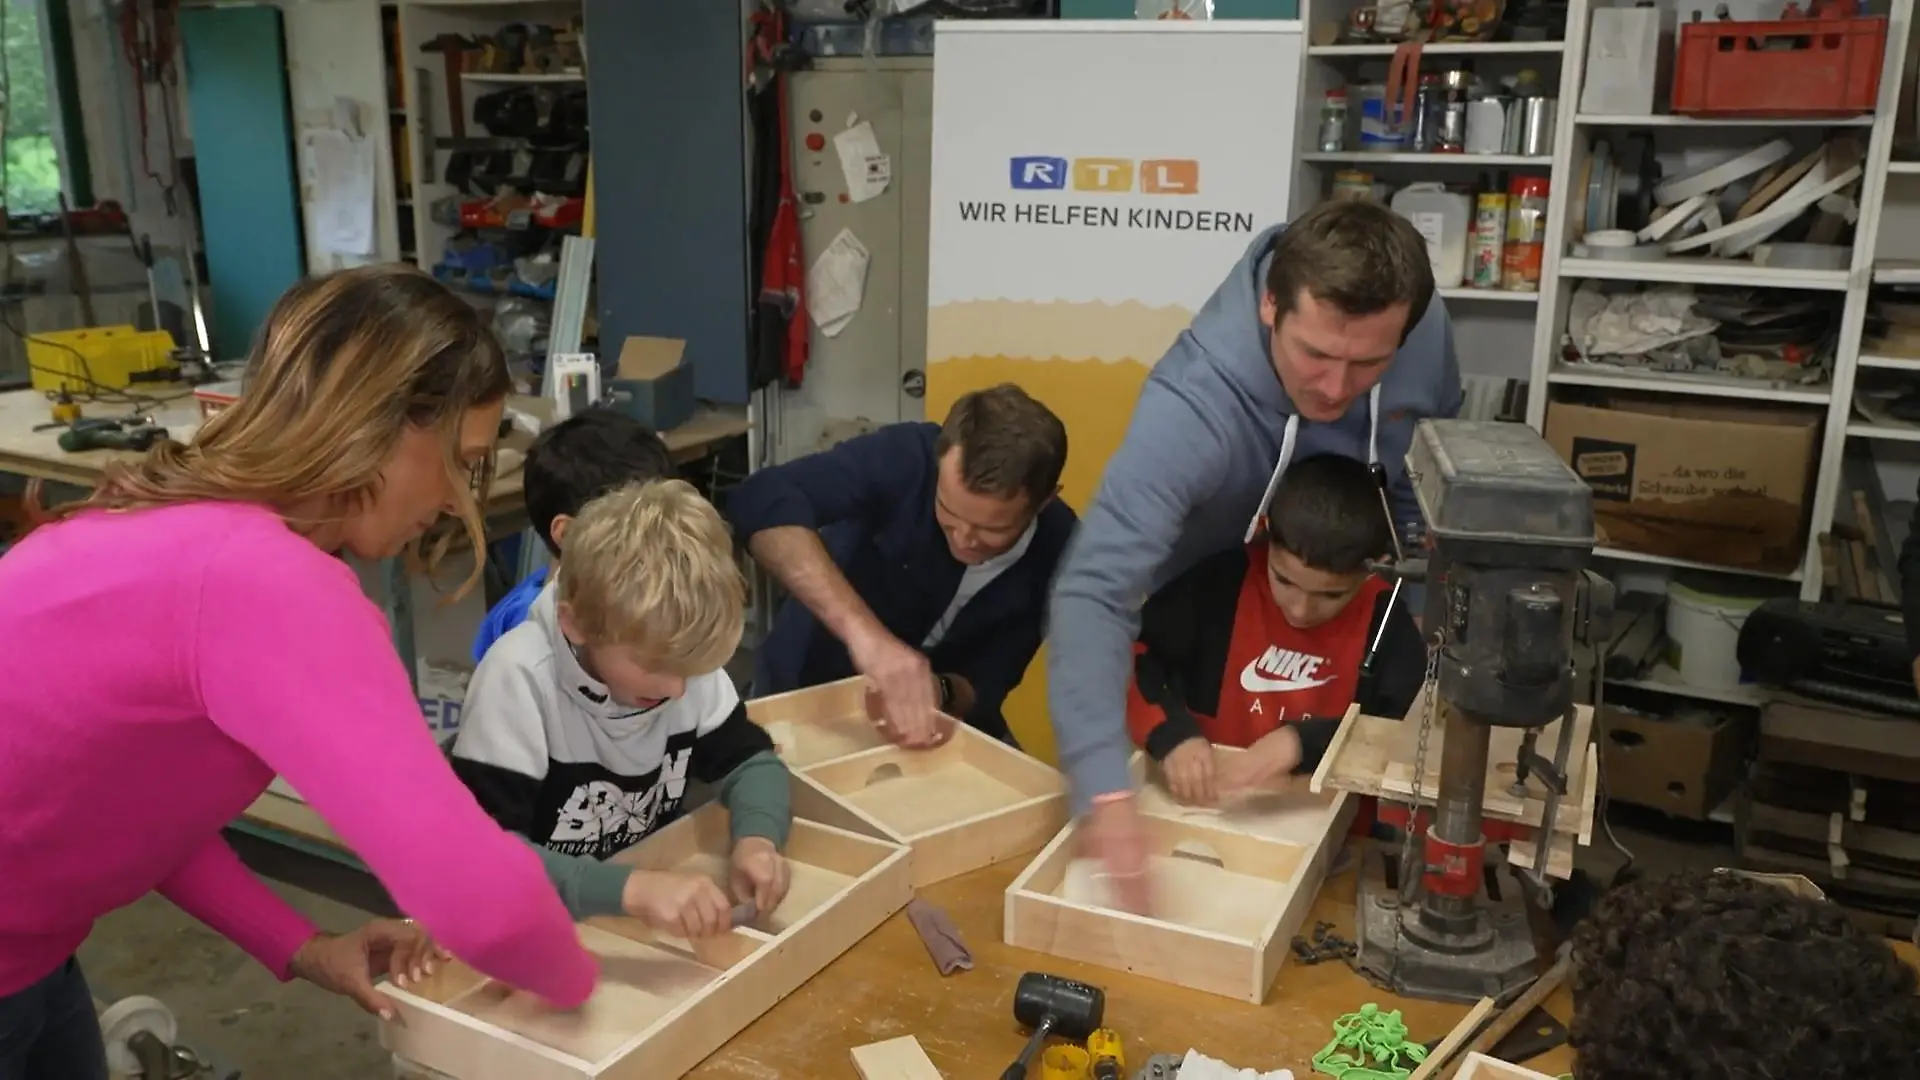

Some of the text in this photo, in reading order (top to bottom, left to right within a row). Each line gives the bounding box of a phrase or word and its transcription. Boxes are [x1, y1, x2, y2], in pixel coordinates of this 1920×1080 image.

[1020, 160, 1187, 190] RTL
[959, 201, 1254, 233] WIR HELFEN KINDERN
[1256, 644, 1324, 682] NIKE
